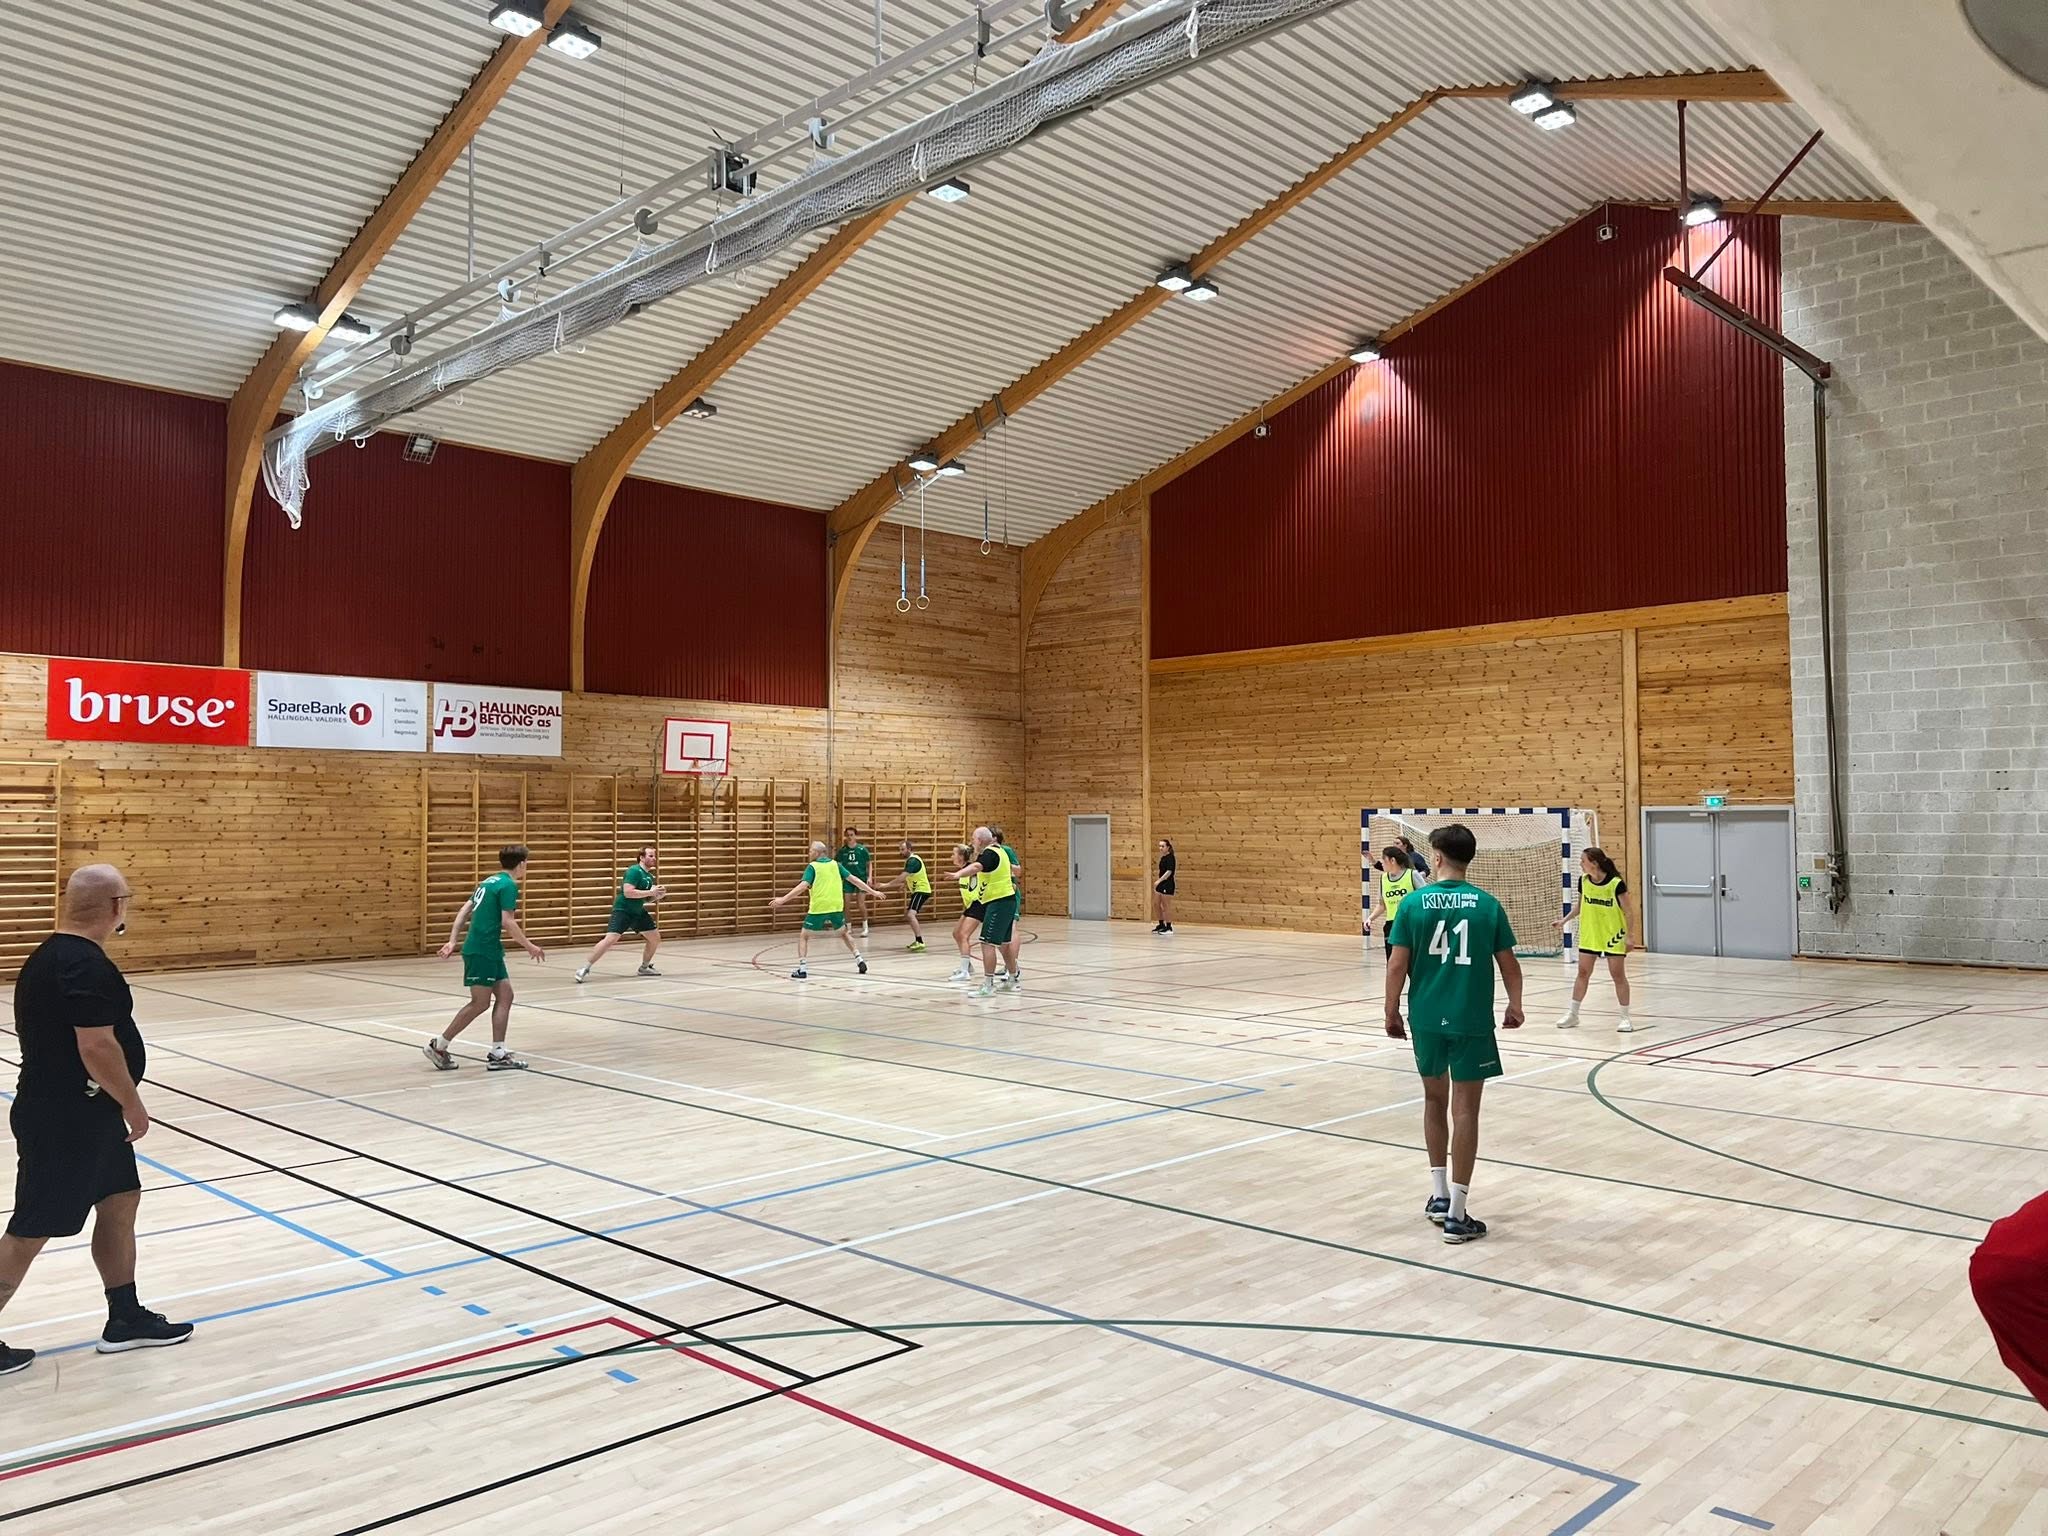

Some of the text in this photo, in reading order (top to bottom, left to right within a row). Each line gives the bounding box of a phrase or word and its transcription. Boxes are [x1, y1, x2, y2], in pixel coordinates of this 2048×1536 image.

[268, 699, 347, 715] SpareBank
[479, 702, 562, 717] HALLINGDAL
[268, 714, 313, 722] HALLINGDAL
[434, 699, 477, 738] HB
[480, 713, 551, 727] BETONG as
[1386, 888, 1408, 898] coop
[1422, 893, 1460, 909] KIWI
[1461, 900, 1477, 908] pris
[1584, 895, 1613, 907] hummel
[1428, 919, 1472, 966] 41
